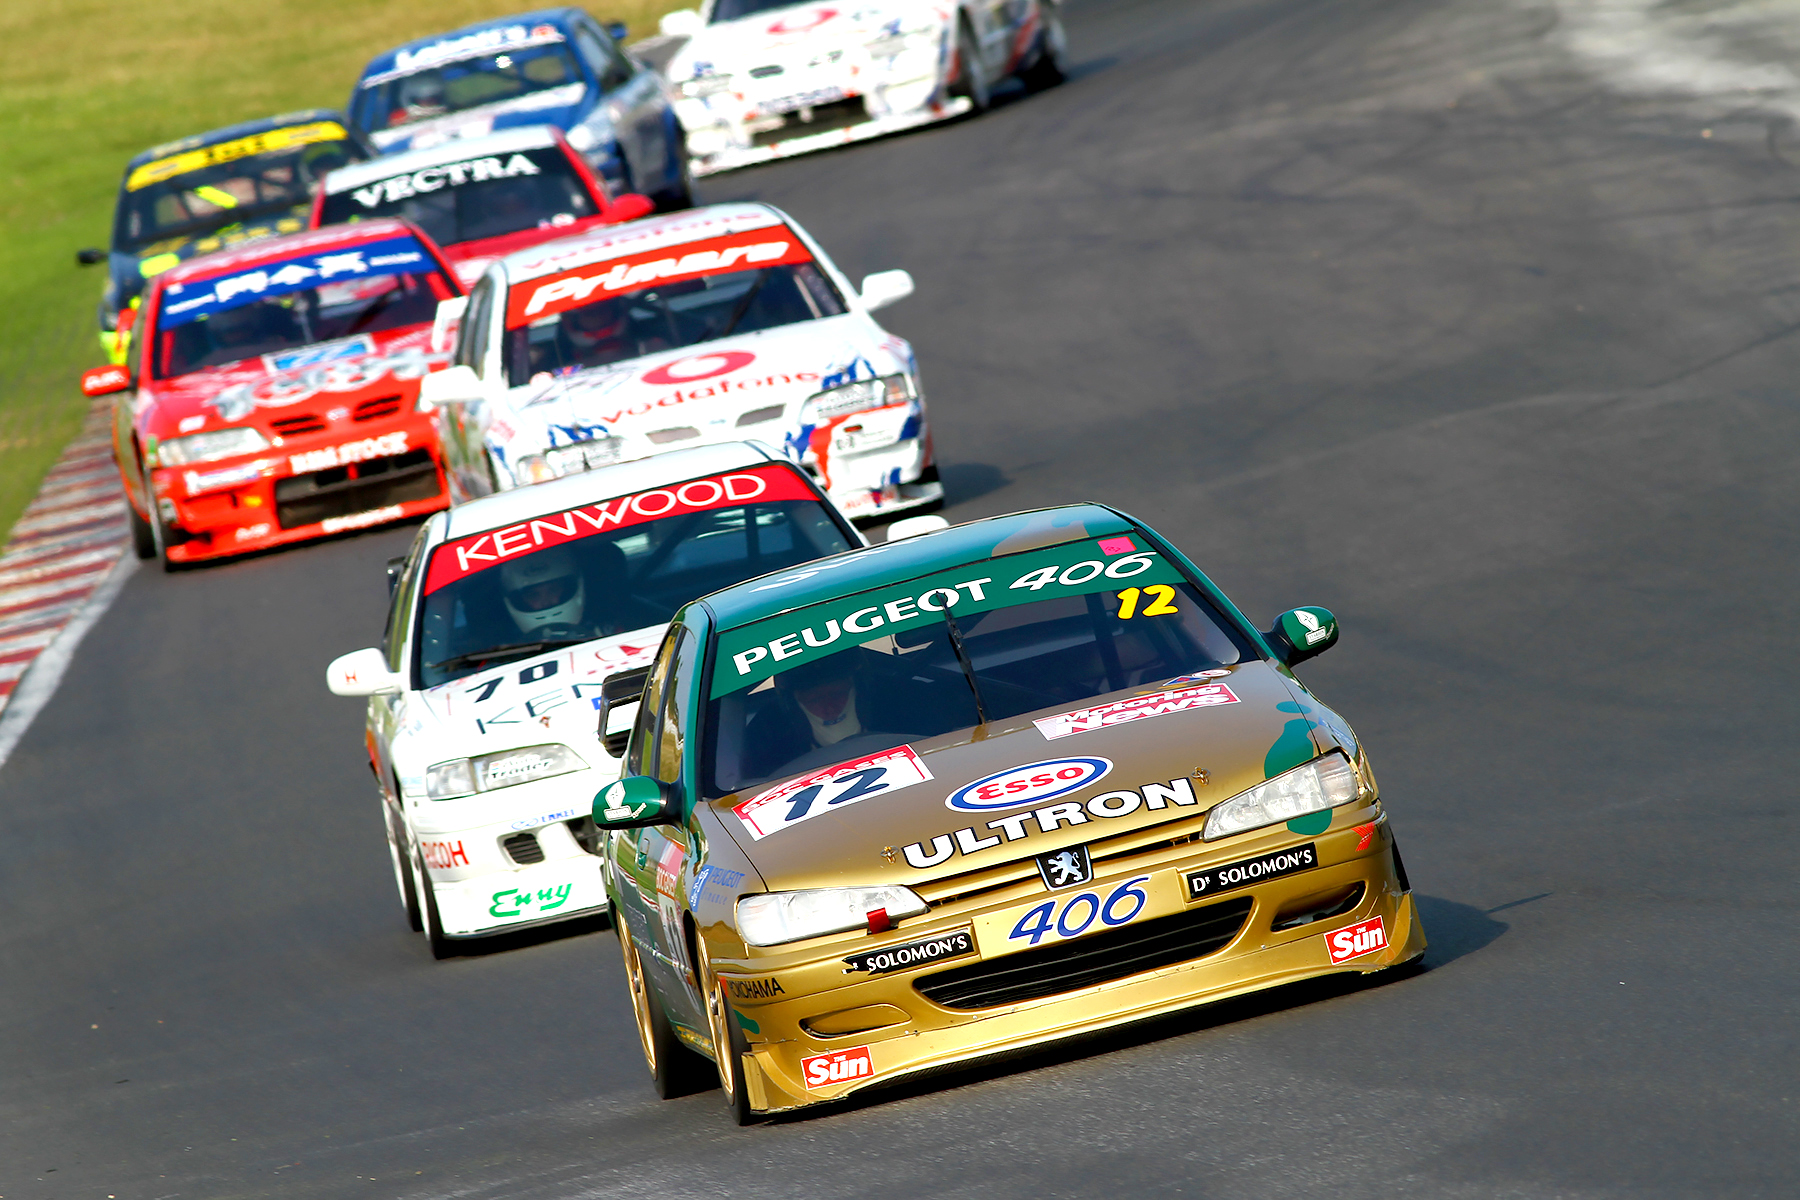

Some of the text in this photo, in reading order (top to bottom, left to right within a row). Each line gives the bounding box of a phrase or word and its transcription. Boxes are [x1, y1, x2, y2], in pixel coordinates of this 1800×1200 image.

[352, 153, 541, 209] VECTRA
[600, 372, 820, 424] vodafone
[455, 473, 767, 572] KENWOOD
[732, 551, 1158, 676] PEUGEOT 406
[1116, 584, 1179, 620] 12
[464, 660, 559, 704] 70
[1055, 693, 1231, 737] News
[1056, 684, 1222, 725] Motoring
[784, 767, 891, 822] 12
[902, 776, 1199, 869] ULTRON
[709, 867, 745, 889] PEUGEOT
[1218, 849, 1313, 886] SOLOMON'S
[1008, 876, 1151, 945] 406
[866, 935, 968, 972] SOLOMON'S
[1332, 927, 1386, 959] Sun
[808, 1055, 869, 1085] Sun
